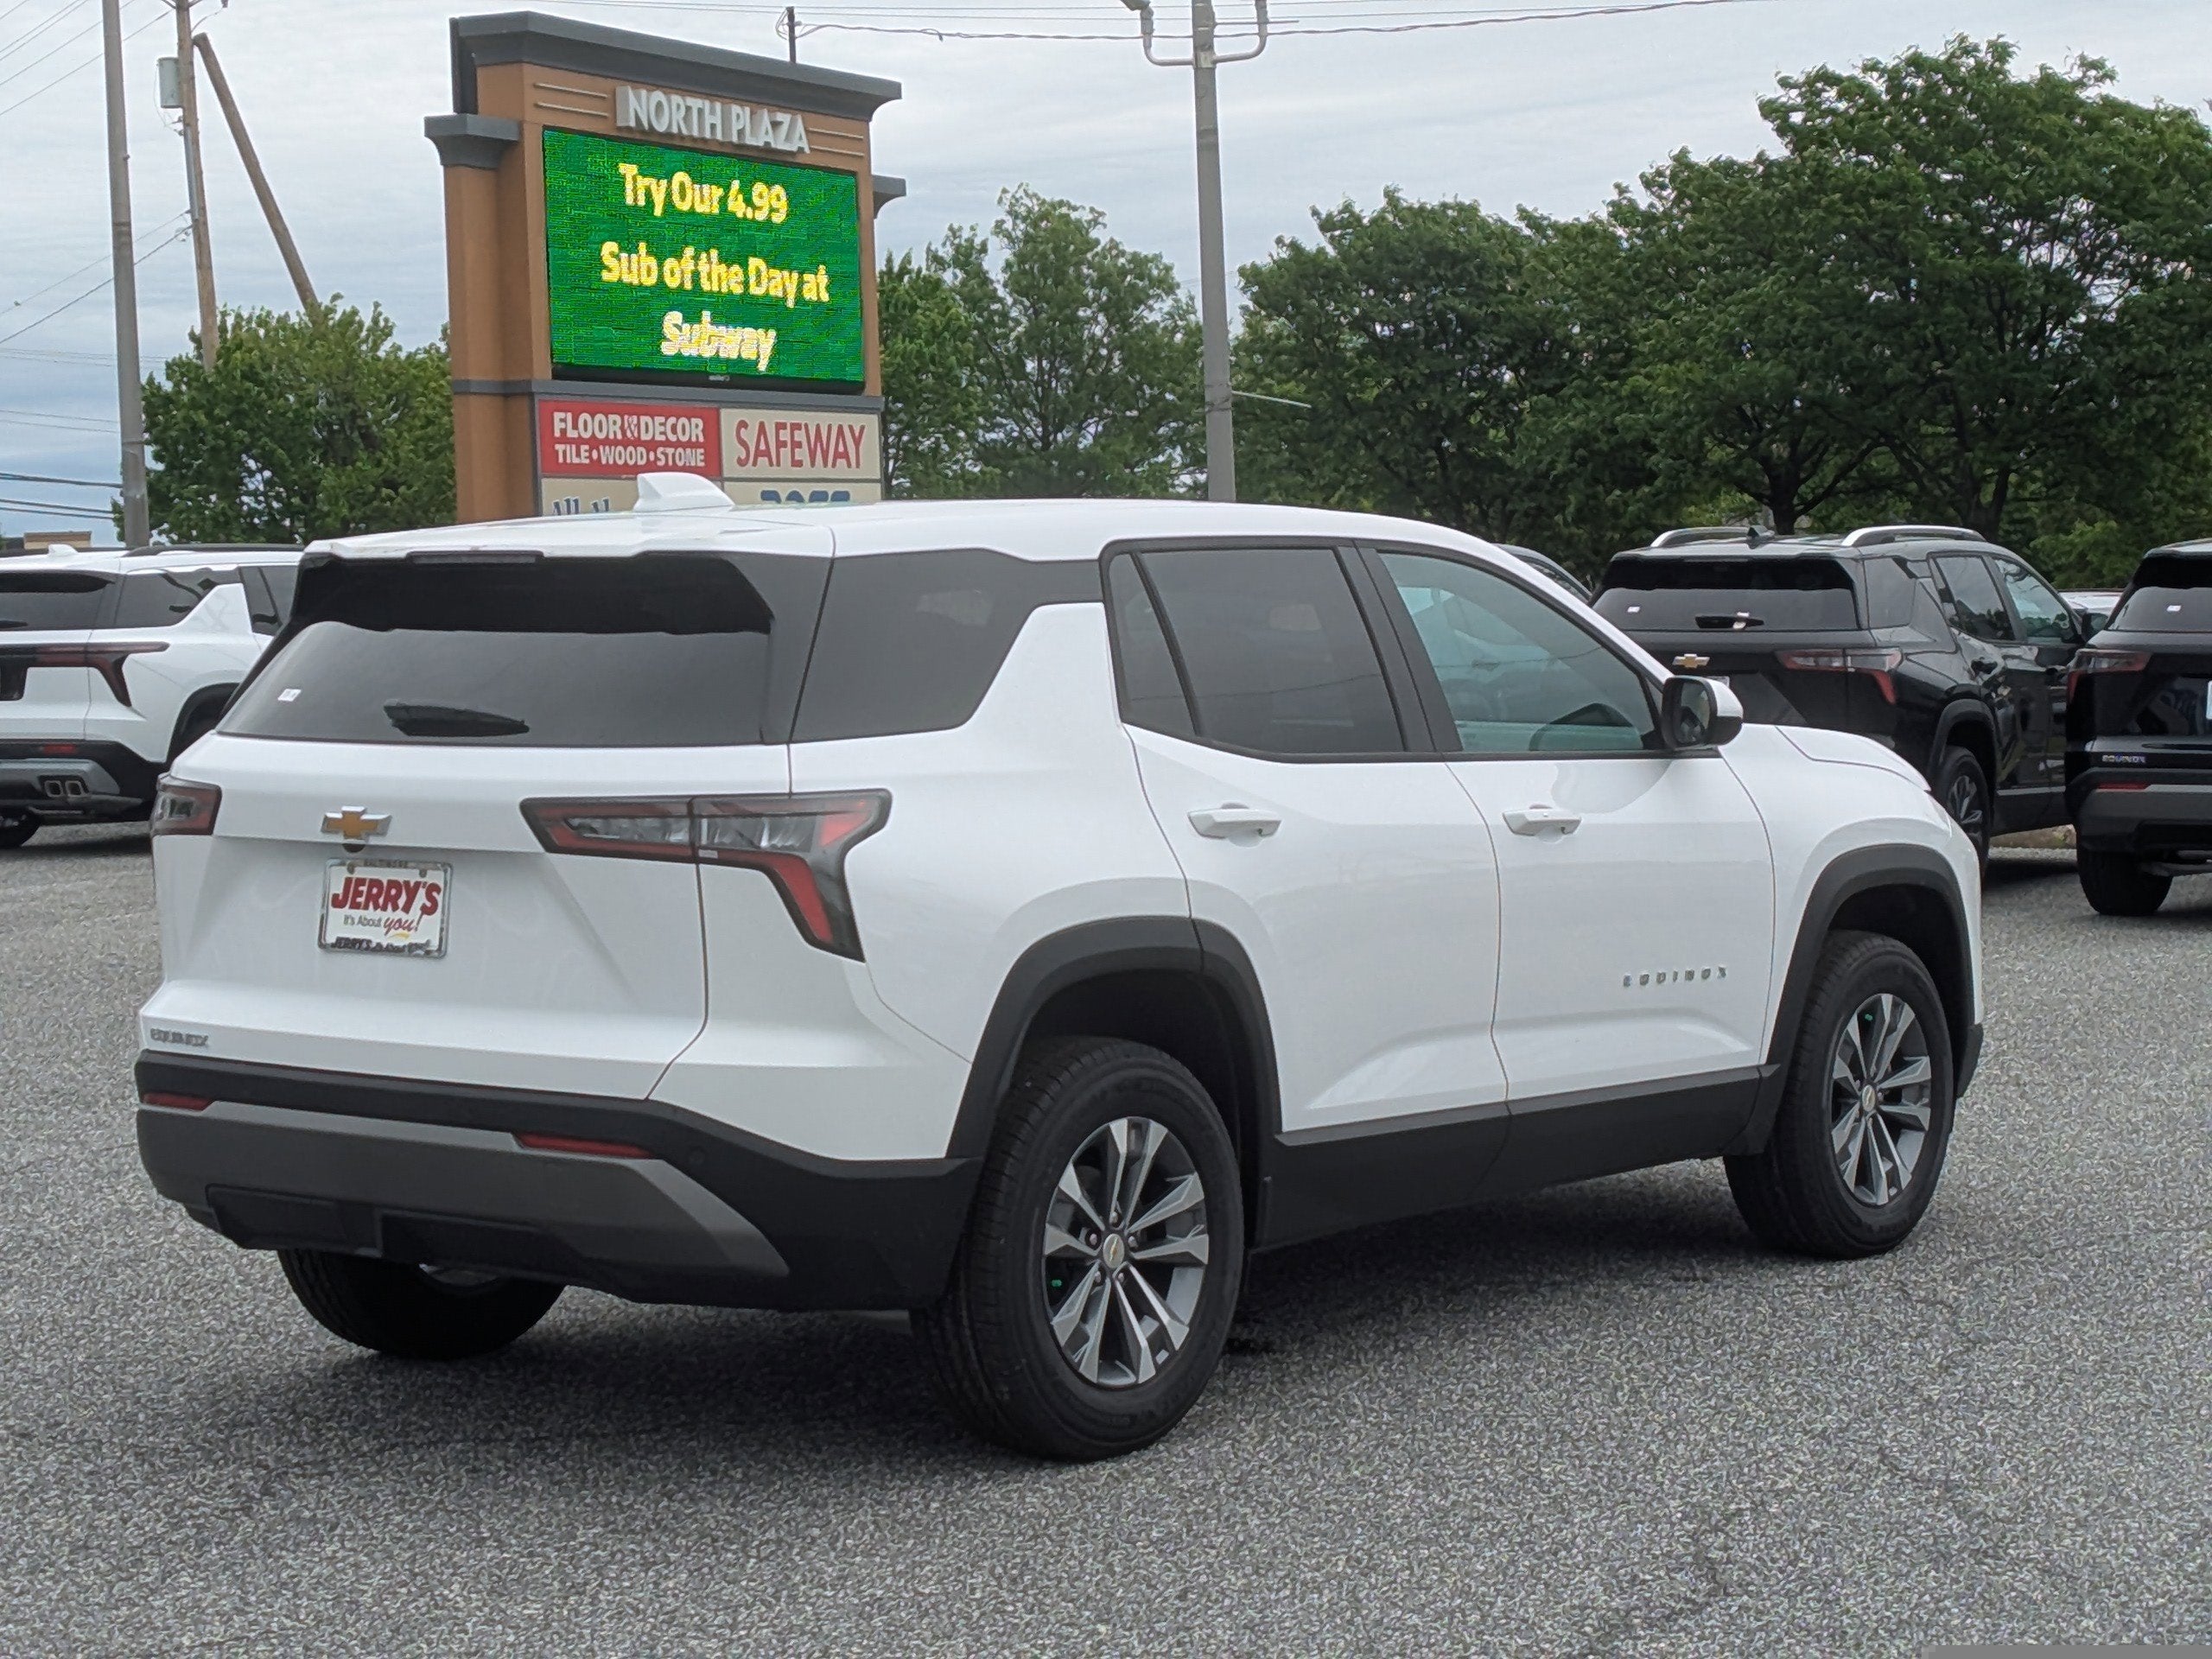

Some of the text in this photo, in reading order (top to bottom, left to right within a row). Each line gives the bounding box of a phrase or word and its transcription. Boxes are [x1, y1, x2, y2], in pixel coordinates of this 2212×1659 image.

[615, 86, 810, 154] NORTH PLAZA
[618, 162, 789, 224] Try Our 4.99
[601, 241, 830, 308] Sub of the Day at
[660, 310, 777, 372] Subway
[553, 411, 623, 440] FLOOR
[639, 416, 705, 442] DECOR
[735, 419, 867, 469] SAFEWAY
[330, 876, 442, 917] JERRY'S
[1622, 965, 1727, 988] EQUINOX
